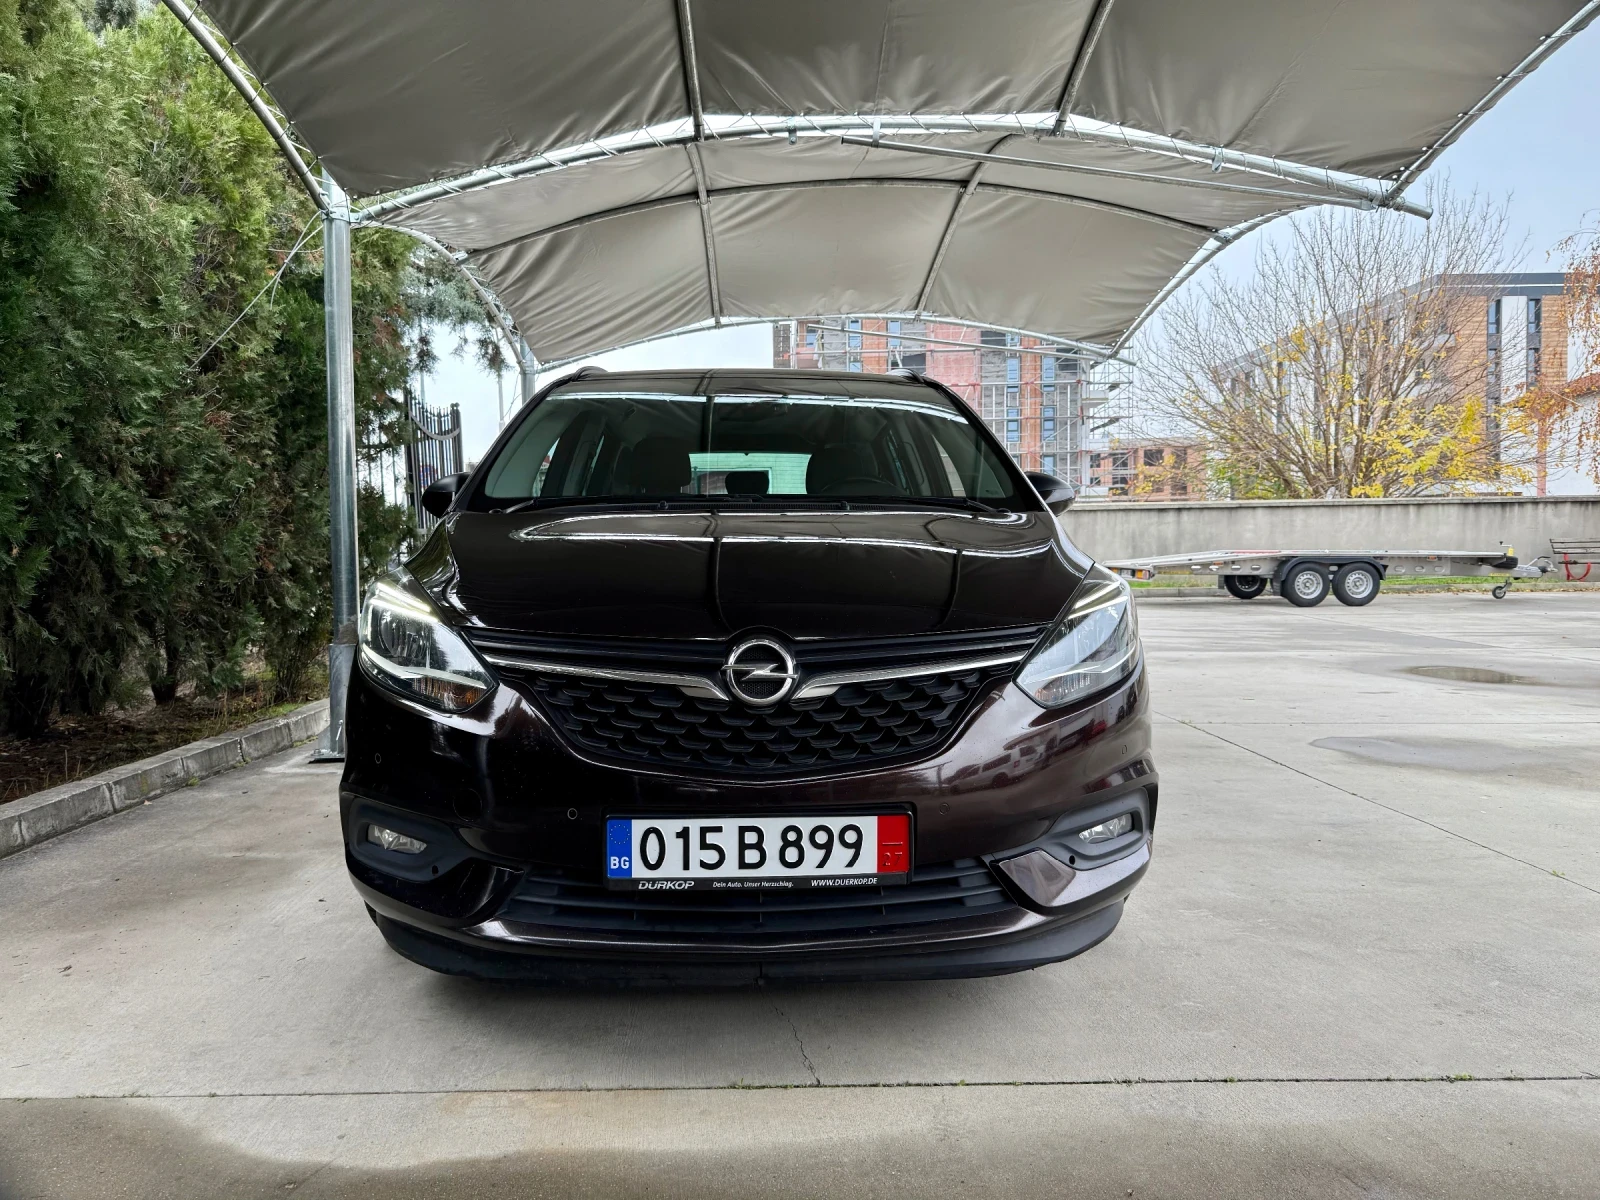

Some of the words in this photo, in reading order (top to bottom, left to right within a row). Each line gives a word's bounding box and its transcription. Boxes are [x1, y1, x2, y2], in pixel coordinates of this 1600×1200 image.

[778, 823, 864, 869] 899
[610, 856, 630, 869] BG
[811, 877, 878, 887] WWW.DUERKOP.DE
